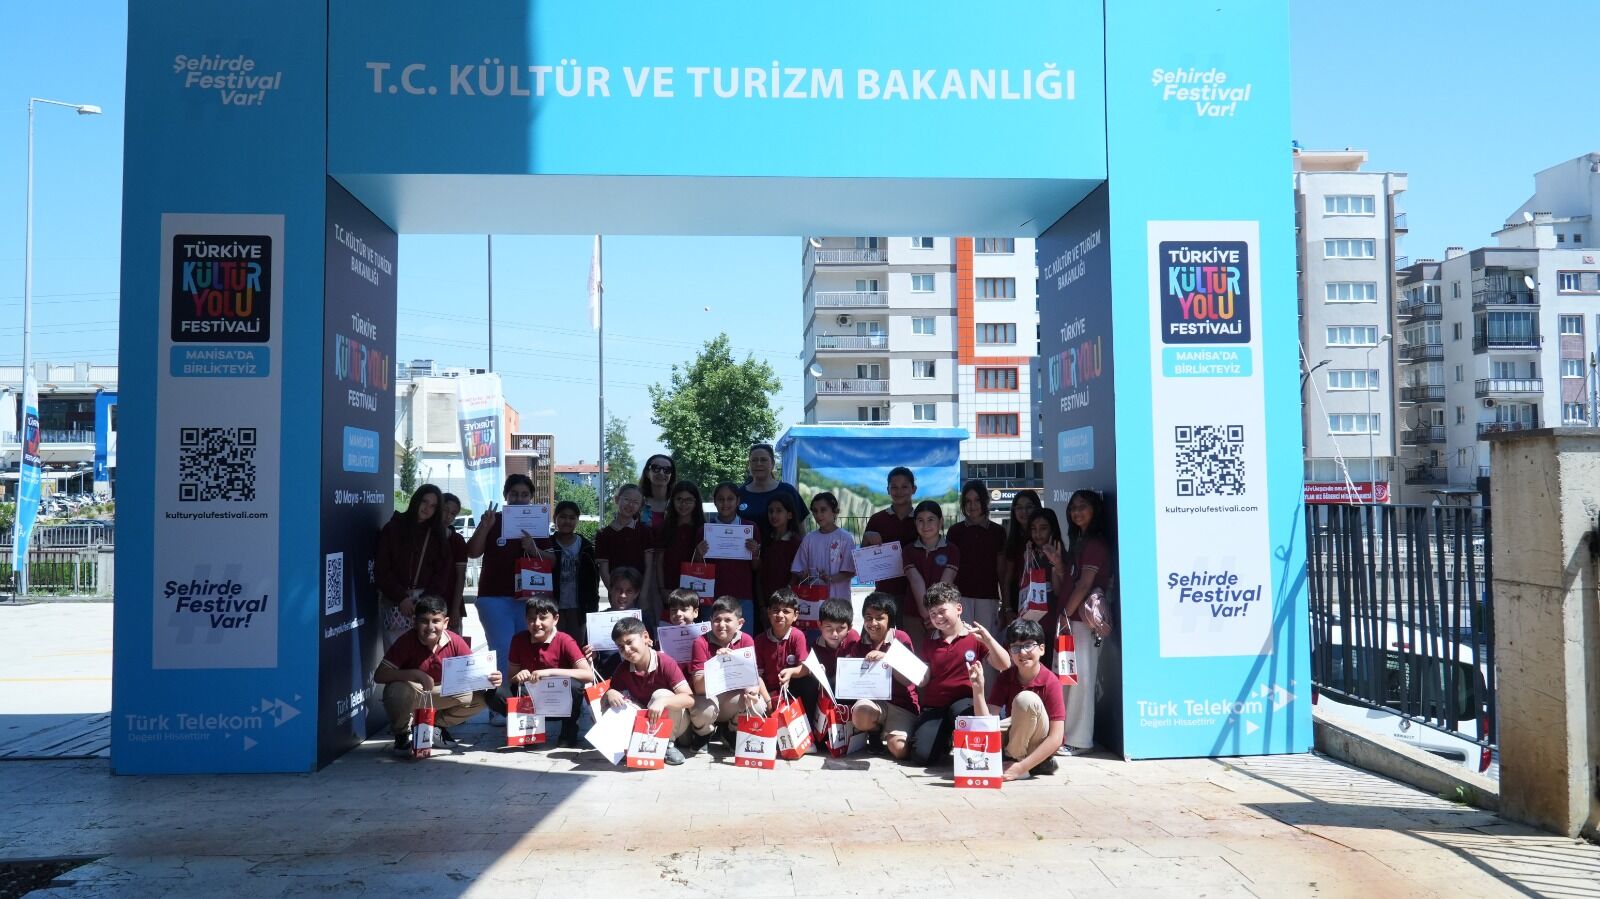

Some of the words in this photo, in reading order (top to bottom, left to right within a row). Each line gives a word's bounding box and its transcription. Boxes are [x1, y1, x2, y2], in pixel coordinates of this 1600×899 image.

[172, 54, 255, 73] Şehirde
[185, 72, 282, 90] Festival
[366, 62, 437, 95] T.C.
[450, 58, 610, 97] KÜLTÜR
[623, 66, 674, 98] VE
[687, 60, 844, 99] TURİZM
[858, 62, 1075, 100] BAKANLIĞI
[1152, 68, 1226, 86] Şehirde
[220, 90, 265, 106] Var!
[1163, 84, 1252, 101] Festival
[1196, 102, 1237, 116] Var!
[184, 240, 262, 258] TÜRKİYE
[346, 232, 366, 258] KÜLTÜR
[366, 248, 374, 264] VE
[374, 251, 392, 276] TURİZM
[1052, 249, 1072, 276] KÜLTÜR
[1072, 246, 1080, 263] VE
[1080, 229, 1101, 254] TURİZM
[1168, 246, 1240, 264] TÜRKİYE
[182, 261, 261, 295] KÜLTÜR
[351, 256, 378, 286] BAKANLIĞI
[1058, 260, 1086, 290] BAKANLIĞI
[1168, 266, 1241, 298] KÜLTÜR
[193, 288, 253, 318] YOLU
[1180, 291, 1234, 320] YOLU
[181, 317, 260, 334] FESTİVALİ
[352, 312, 377, 340] TÜRKİYE
[1060, 316, 1086, 344] TÜRKİYE
[1170, 320, 1242, 335] FESTİVALİ
[186, 347, 254, 360] MANİSA'DA
[335, 333, 367, 388] KÜLTÜR
[368, 348, 388, 391] YOLU
[1176, 349, 1238, 361] MANİSA'DA
[184, 362, 256, 374] BİRLİKTEYİZ
[1048, 347, 1077, 396] KÜLTÜR
[1078, 336, 1102, 381] YOLU
[1174, 362, 1241, 374] BİRLİKTEYİZ
[348, 388, 378, 412] FESTİVALİ
[1060, 386, 1090, 414] FESTİVALİ
[334, 490, 342, 504] 30
[343, 490, 358, 508] Mayıs
[363, 490, 366, 504] 7
[366, 489, 384, 504] Haziran
[165, 510, 268, 522] kulturyolufestivali.com
[1166, 505, 1258, 514] kulturyolufestivali.com
[164, 580, 242, 598] Şehirde
[1168, 571, 1238, 590] Şehirde
[1179, 585, 1262, 603] Festival
[176, 595, 268, 614] Festival
[1210, 603, 1248, 618] Var!
[210, 613, 252, 629] Var!
[1137, 700, 1178, 717] Türk
[1184, 698, 1263, 716] Telekom
[125, 713, 170, 731] Türk
[176, 713, 262, 730] Telekom
